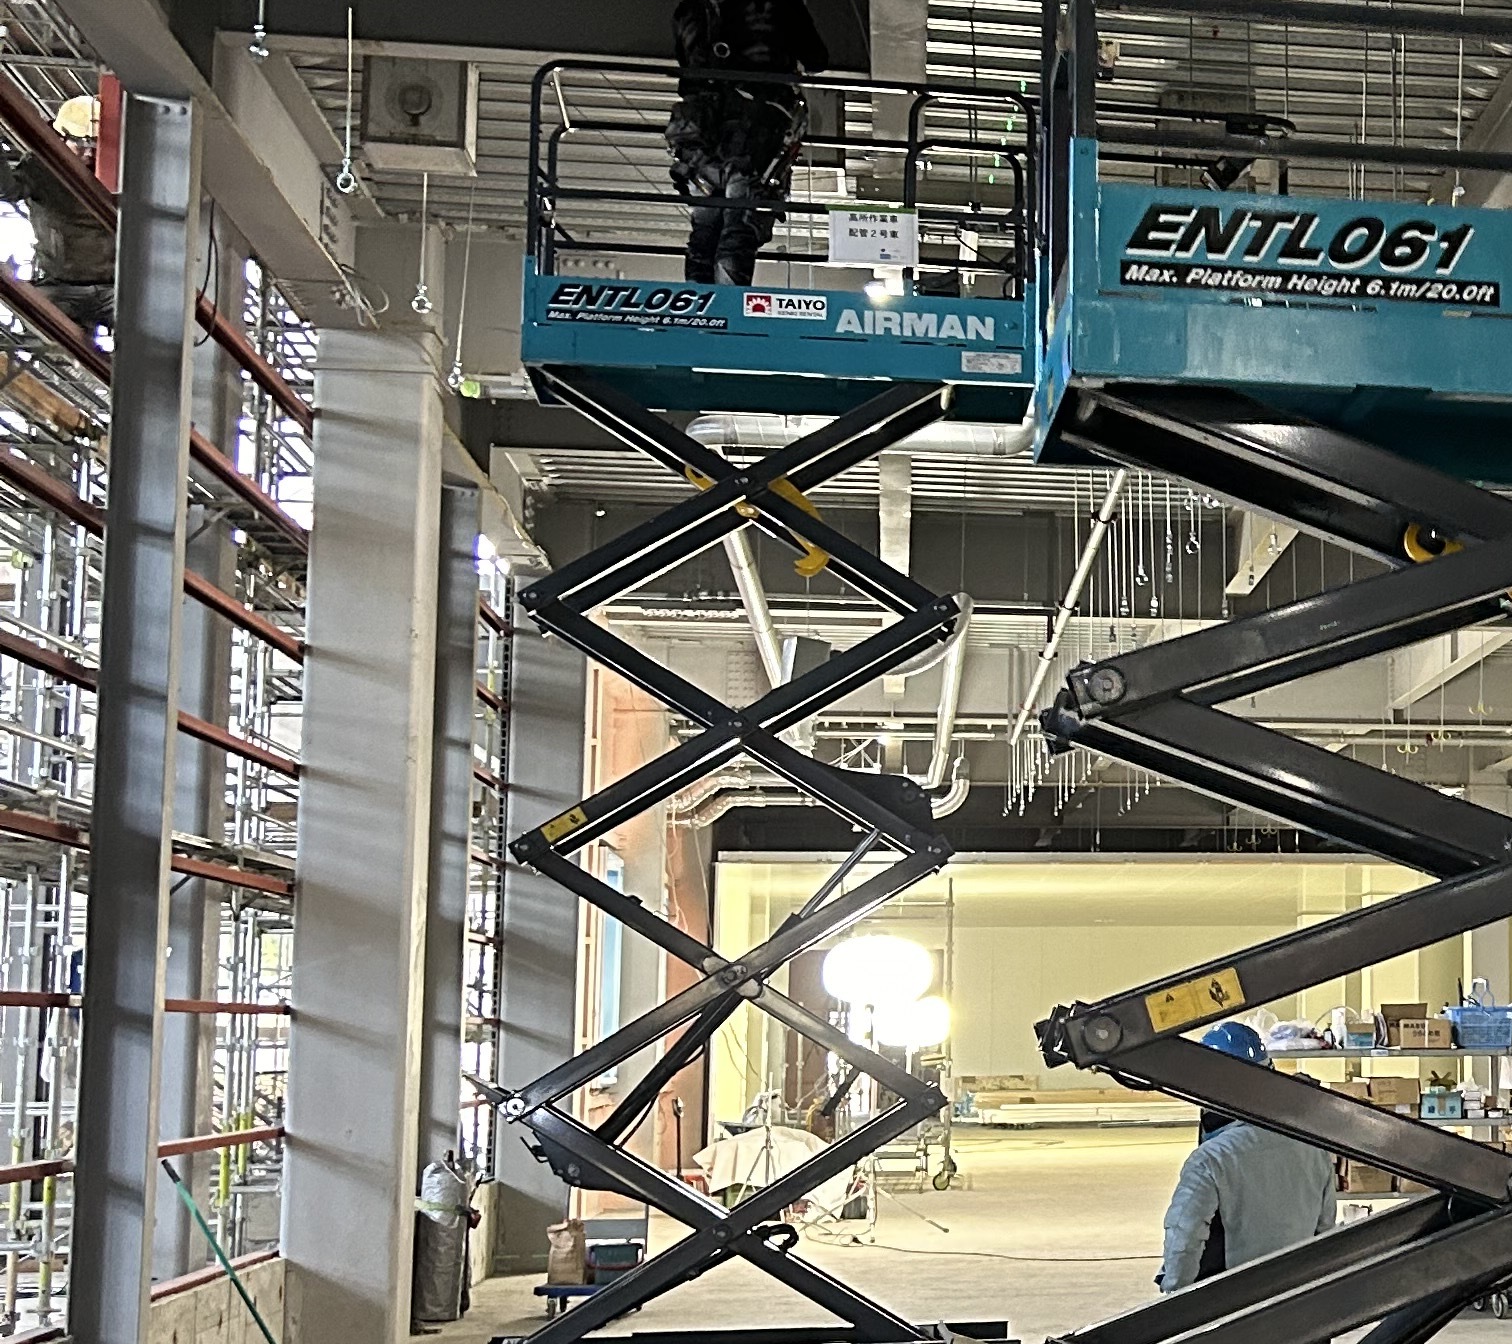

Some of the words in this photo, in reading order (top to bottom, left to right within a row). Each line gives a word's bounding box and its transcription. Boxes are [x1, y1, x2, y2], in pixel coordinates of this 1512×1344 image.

[1125, 263, 1178, 284] Max.
[1186, 268, 1282, 290] Platform
[1287, 273, 1361, 298] Height
[1366, 277, 1495, 303] 6.1m/20.0ft
[776, 298, 826, 311] TAIYO
[576, 311, 623, 323] Platform
[624, 314, 661, 326] Height
[835, 309, 995, 341] AIRMAN
